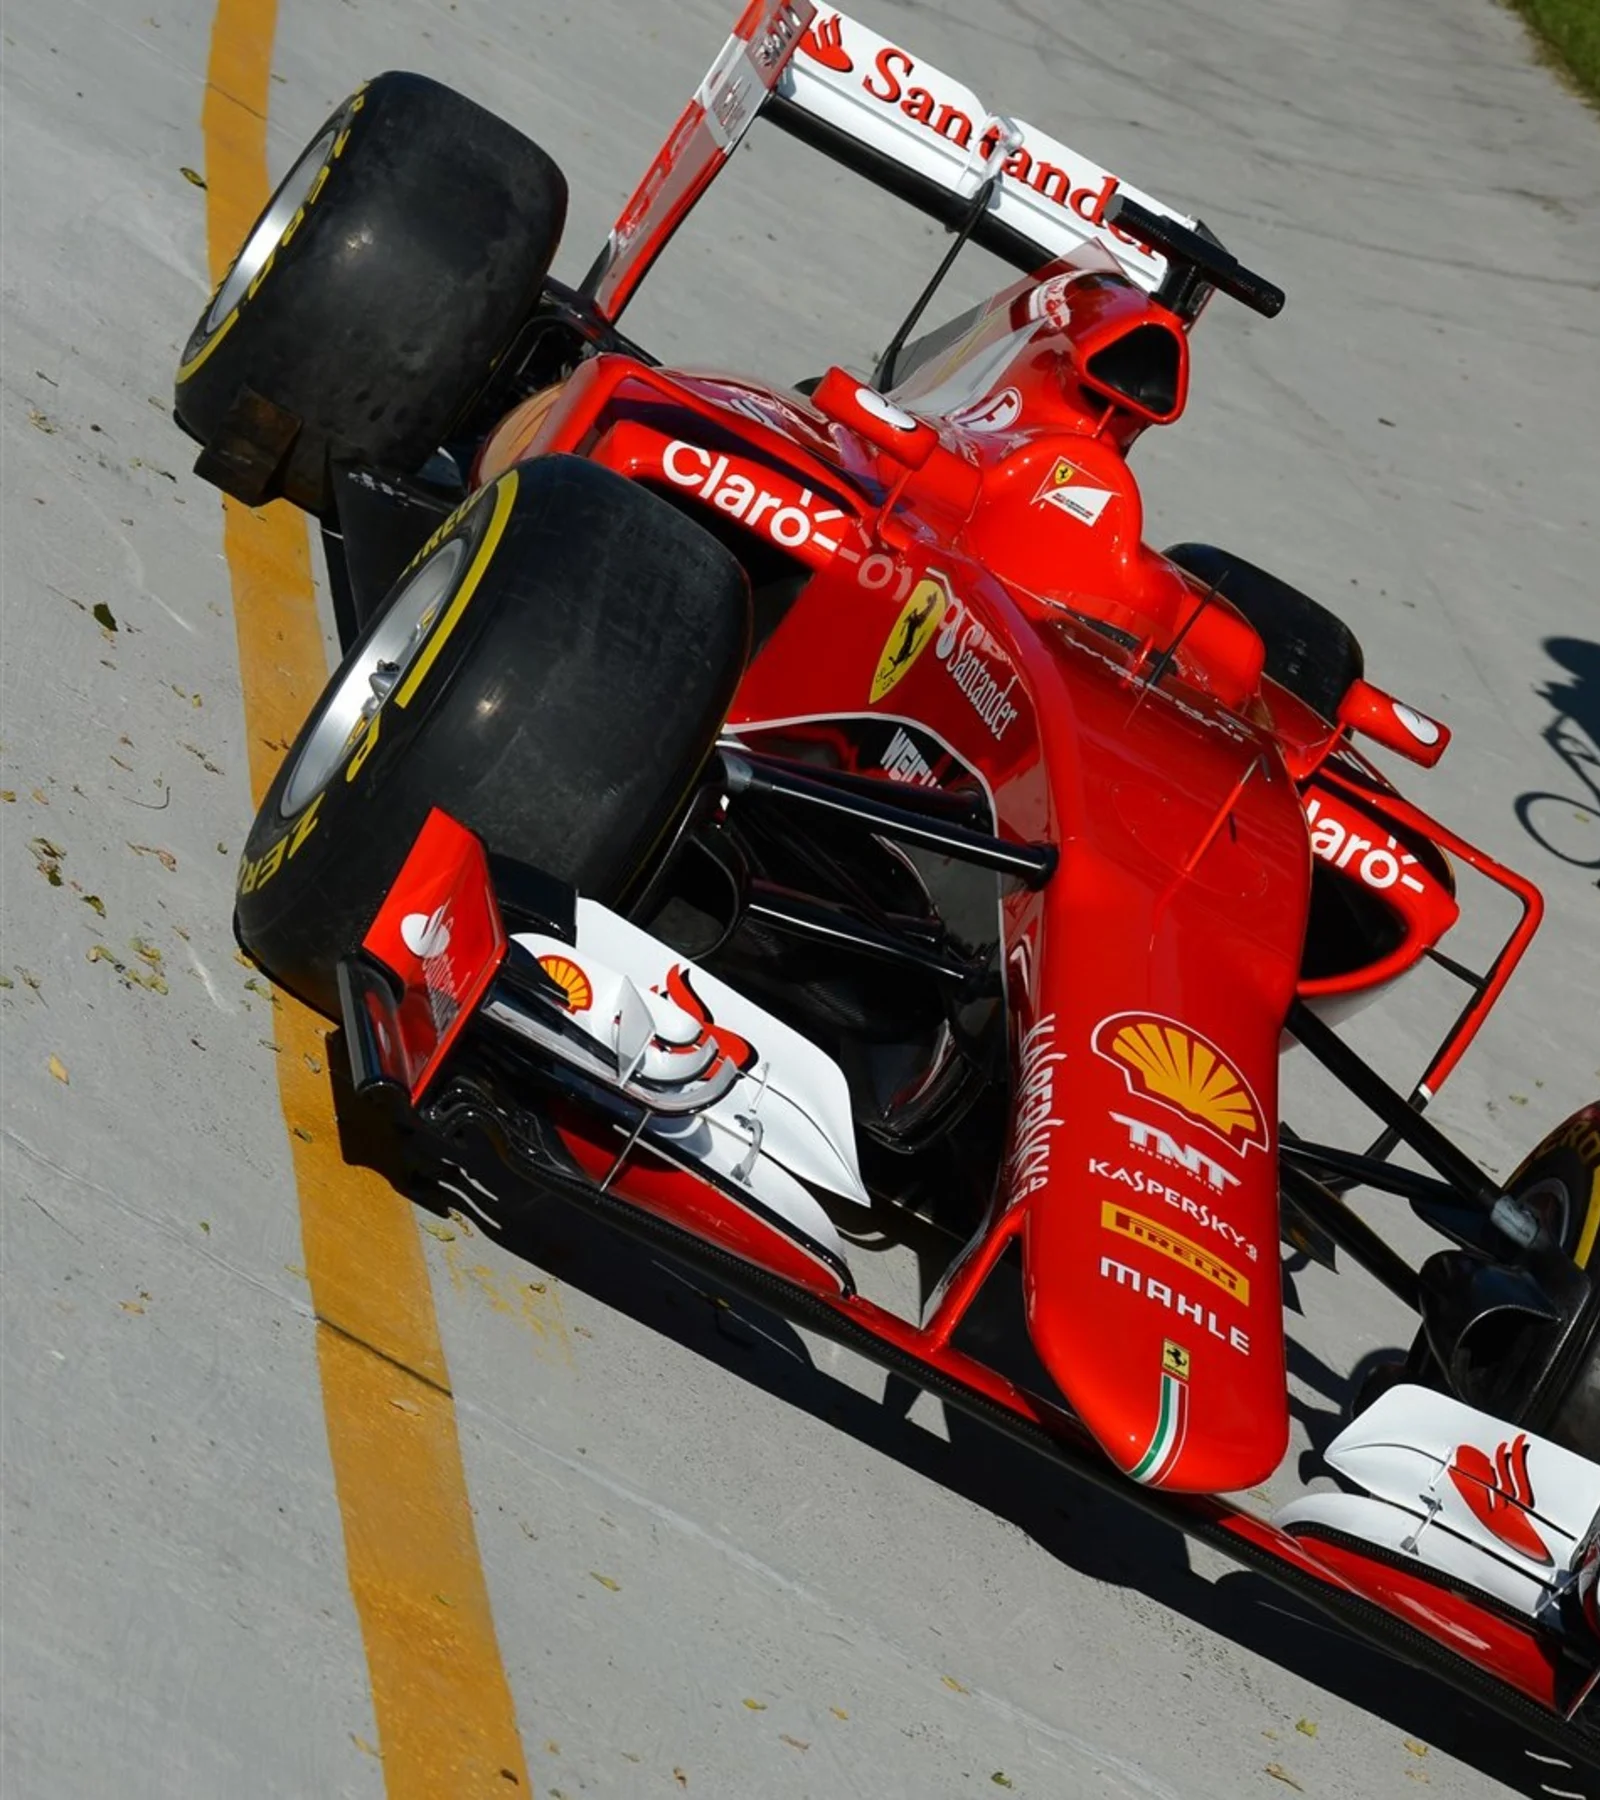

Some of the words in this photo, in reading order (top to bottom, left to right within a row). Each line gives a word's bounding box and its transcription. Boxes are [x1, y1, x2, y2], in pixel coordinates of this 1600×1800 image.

[662, 440, 814, 548] Claro
[946, 623, 1019, 740] Santander
[1305, 800, 1400, 889] laro
[1108, 1110, 1242, 1190] TNT
[1088, 1157, 1246, 1249] KASPERSKY
[1114, 1209, 1239, 1292] PIRELLI
[1100, 1255, 1250, 1356] MAHLE
